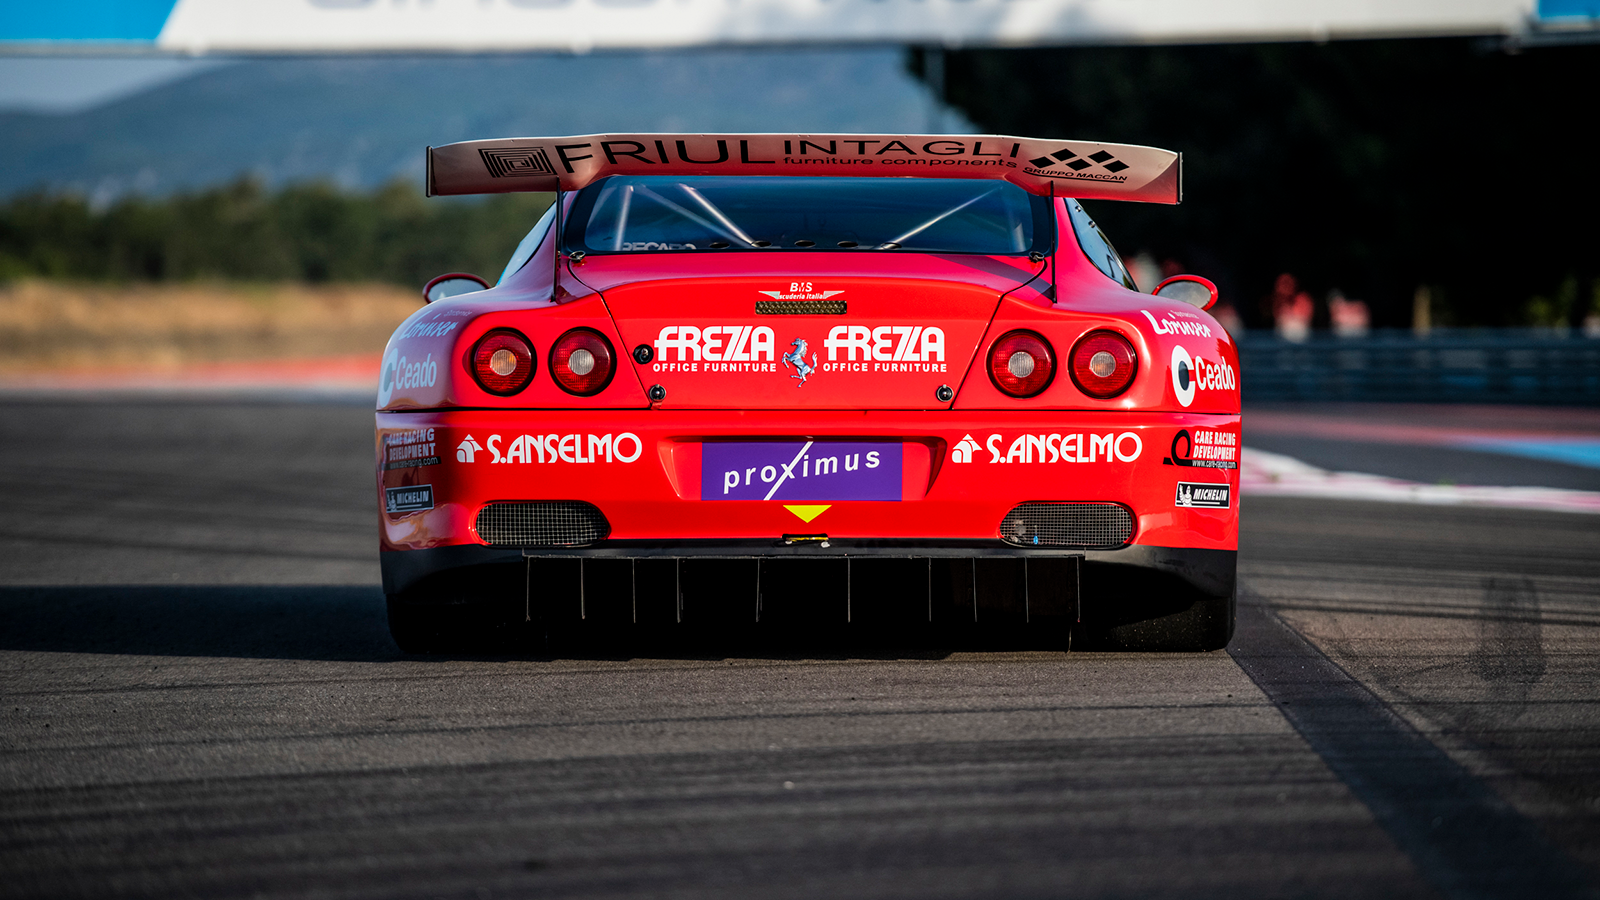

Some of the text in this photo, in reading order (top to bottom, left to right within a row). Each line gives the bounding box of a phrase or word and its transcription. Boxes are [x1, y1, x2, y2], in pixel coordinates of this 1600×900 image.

[783, 155, 1018, 170] furniture components
[1024, 166, 1128, 181] GRUPPO MACCAN
[654, 326, 775, 361] FREZZA
[824, 326, 945, 361] FREZZA
[395, 353, 437, 390] Ceado
[653, 363, 777, 373] OFFICE FURNITURE
[823, 363, 947, 373] OFFICE FURNITURE
[1195, 355, 1235, 391] Ceado
[404, 428, 435, 445] RACING
[1194, 430, 1236, 446] CARE RACING
[389, 442, 436, 460] DEVELOPMENT
[487, 432, 642, 464] S.ANSELMO
[986, 432, 1143, 463] S.ANSELMO
[1193, 445, 1236, 460] DEVELOPMENT
[723, 441, 881, 500] proximus
[396, 490, 429, 504] MICHELIN
[1193, 488, 1228, 501] MICHELIN
